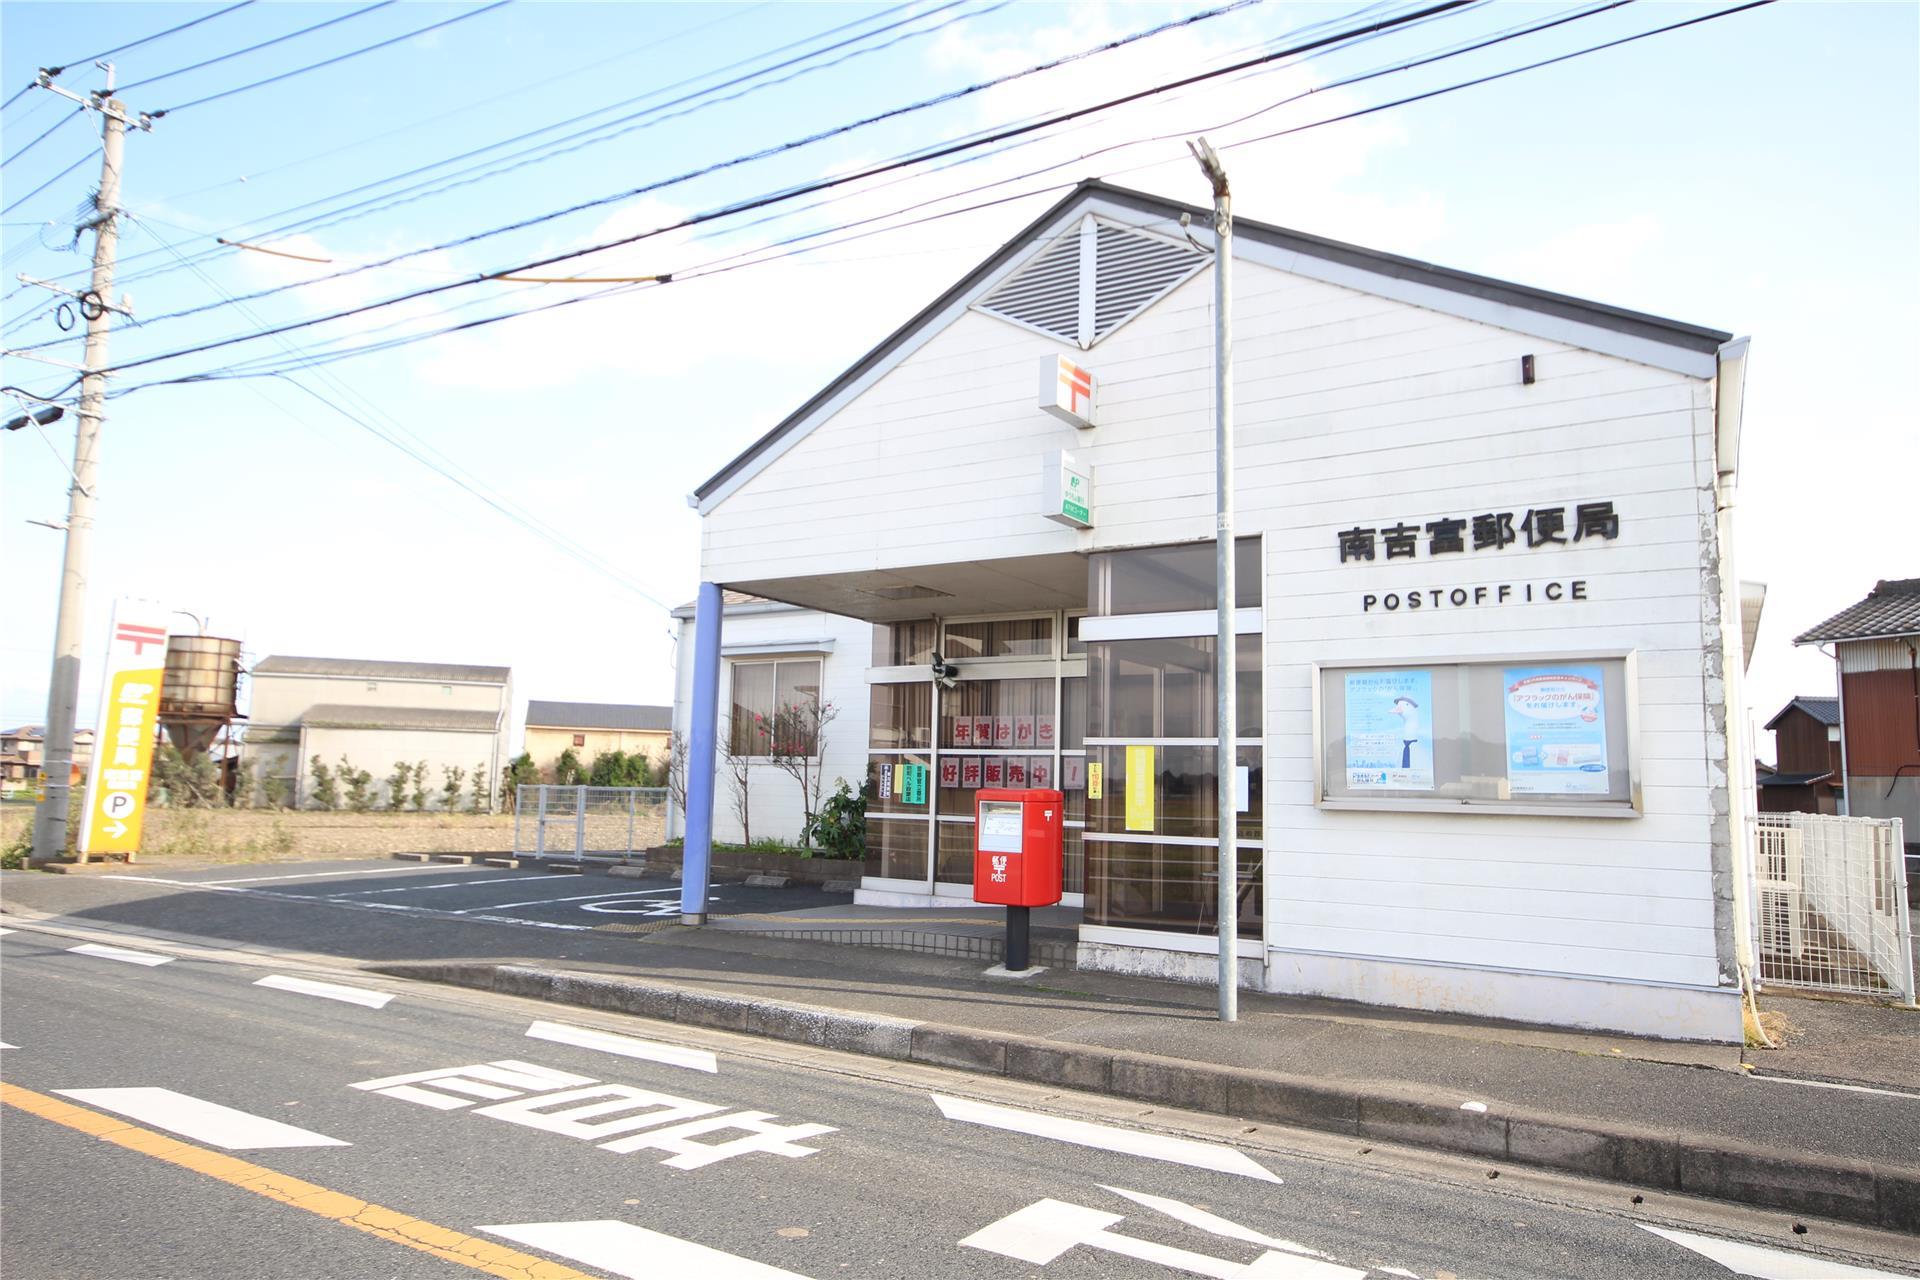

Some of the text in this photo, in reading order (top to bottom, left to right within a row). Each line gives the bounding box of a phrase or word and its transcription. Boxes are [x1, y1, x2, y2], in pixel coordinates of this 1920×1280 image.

[1337, 501, 1620, 563] 南吉富郵便局
[955, 723, 1054, 741] 年賀はがき
[111, 796, 127, 813] P
[991, 873, 1007, 883] POST
